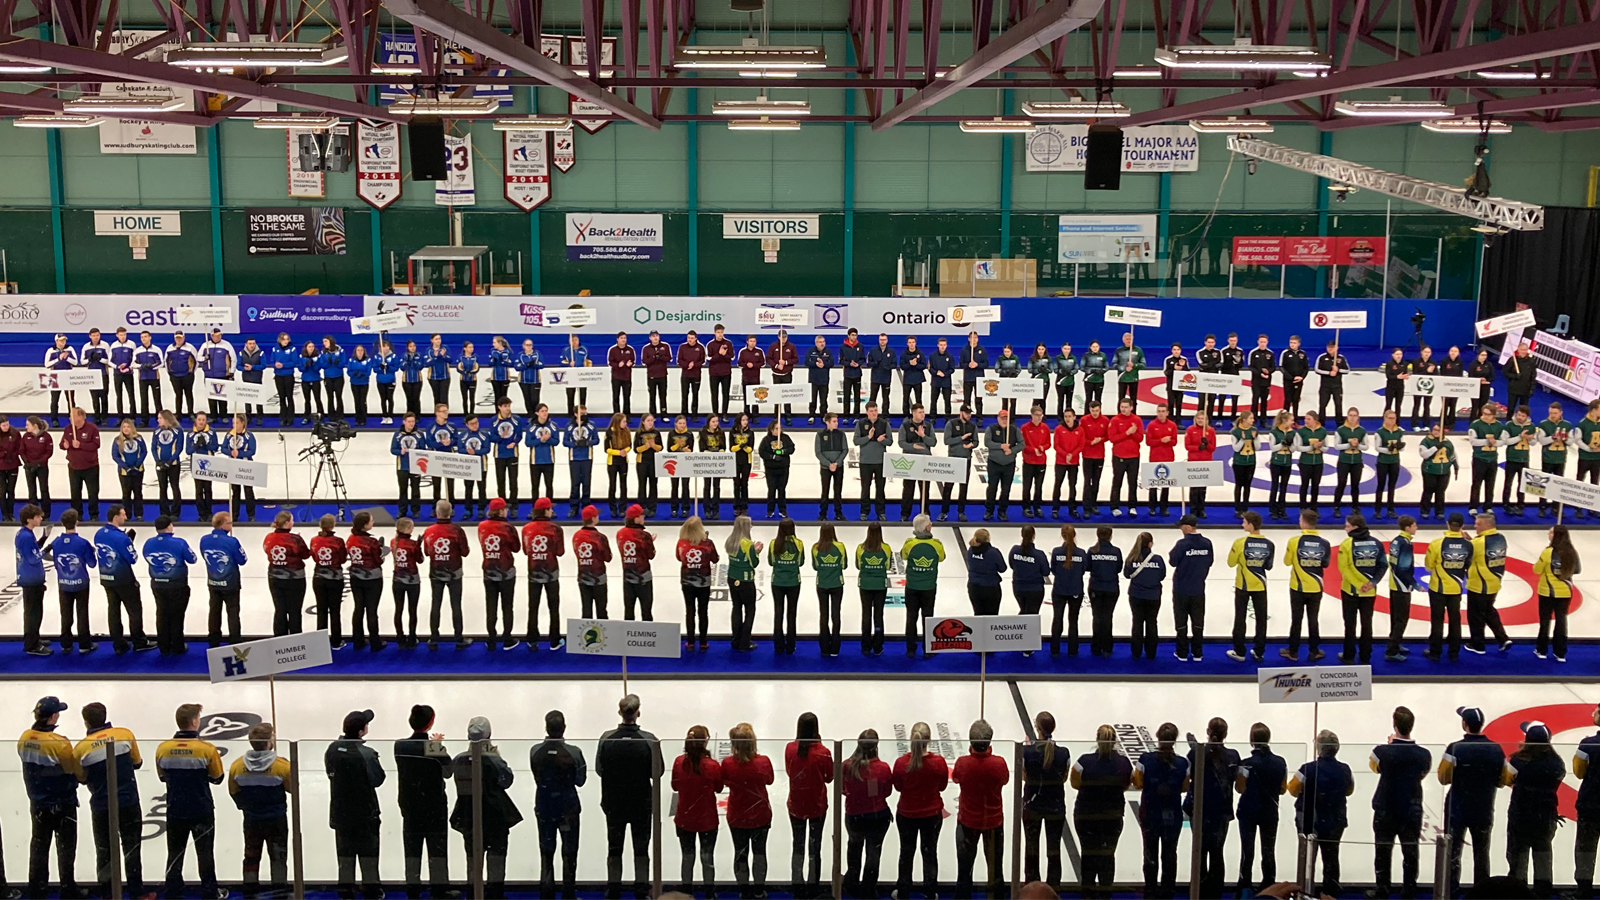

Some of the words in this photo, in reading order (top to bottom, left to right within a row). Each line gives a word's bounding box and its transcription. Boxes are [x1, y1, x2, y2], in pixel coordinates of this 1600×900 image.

[385, 42, 416, 52] HANCOCK
[1135, 137, 1173, 149] MAJOR
[1176, 137, 1197, 147] AAA
[364, 173, 396, 181] 2015
[113, 216, 163, 230] HOME
[250, 214, 266, 222] NO
[267, 214, 306, 222] BROKER
[250, 223, 260, 231] IS
[260, 223, 280, 231] THE
[280, 223, 307, 231] SAME
[588, 227, 657, 236] Back2Health
[734, 220, 809, 234] VISITORS
[259, 310, 299, 323] Sudbury
[655, 310, 723, 323] Desjardins
[882, 311, 946, 324] Ontario
[434, 455, 459, 463] SOUTHERN
[195, 470, 229, 479] COUGARS
[442, 469, 472, 477] TECHNOLOGY
[1553, 479, 1581, 490] NORTHERN
[1581, 486, 1600, 494] ALBERT
[1560, 488, 1586, 499] INSTITUTE
[1559, 494, 1594, 507] TECHNOLOGY
[1013, 553, 1035, 563] BENDER
[626, 630, 657, 638] FLEMING
[275, 644, 306, 655] HUMBER
[932, 641, 971, 651] FALCONS
[277, 654, 307, 664] COLLEGE
[1273, 673, 1313, 688] THUNDER
[1316, 681, 1353, 689] UNIVERSITY
[1320, 690, 1359, 698] EDMONTON
